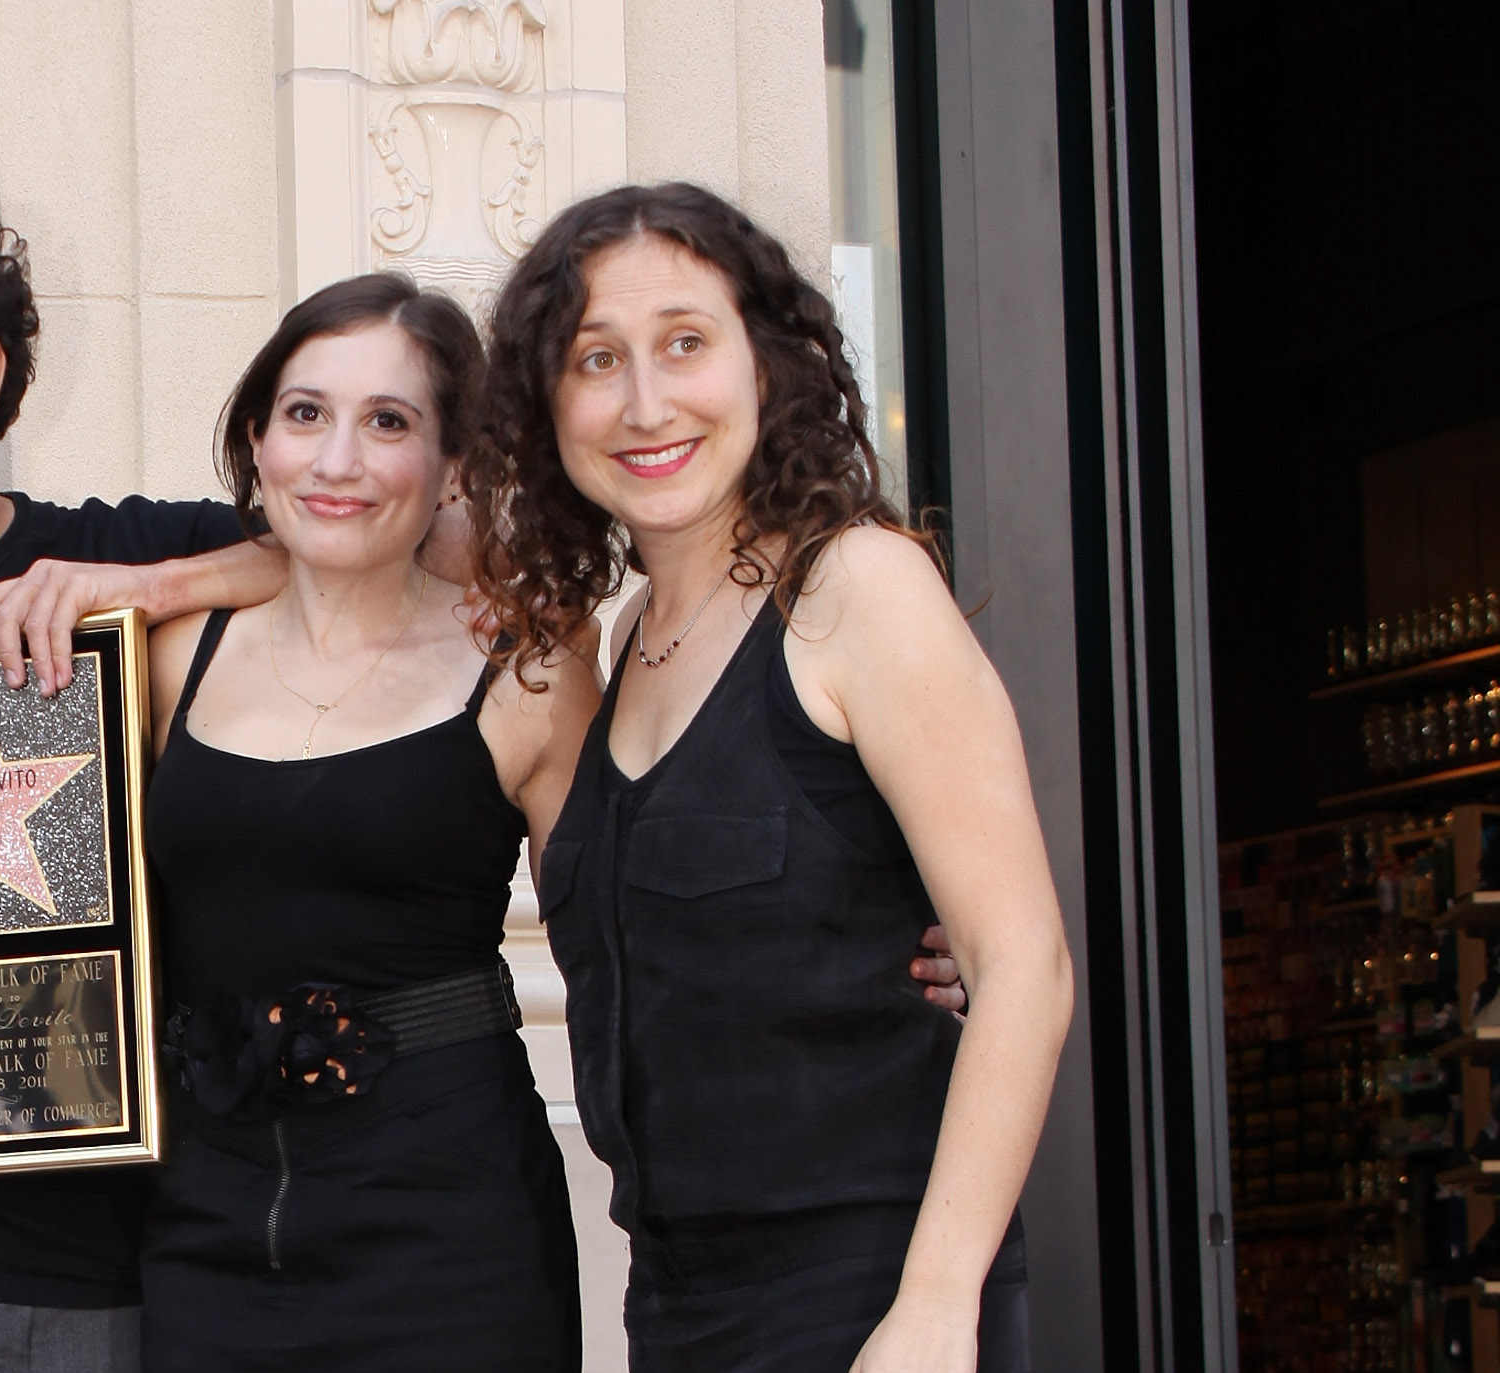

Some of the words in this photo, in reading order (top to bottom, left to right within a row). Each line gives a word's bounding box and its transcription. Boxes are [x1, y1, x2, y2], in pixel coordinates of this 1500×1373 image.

[31, 964, 49, 986] OF
[60, 960, 104, 983] FAME
[18, 1038, 26, 1048] OF
[32, 1036, 52, 1047] YOUR
[57, 1034, 76, 1045] STAR
[81, 1033, 90, 1043] IN
[95, 1032, 108, 1043] THE
[35, 1051, 53, 1071] OF
[65, 1048, 108, 1067] FAME
[19, 1075, 47, 1090] 2011
[21, 1107, 36, 1124] OF
[44, 1102, 111, 1122] COMMERCE
